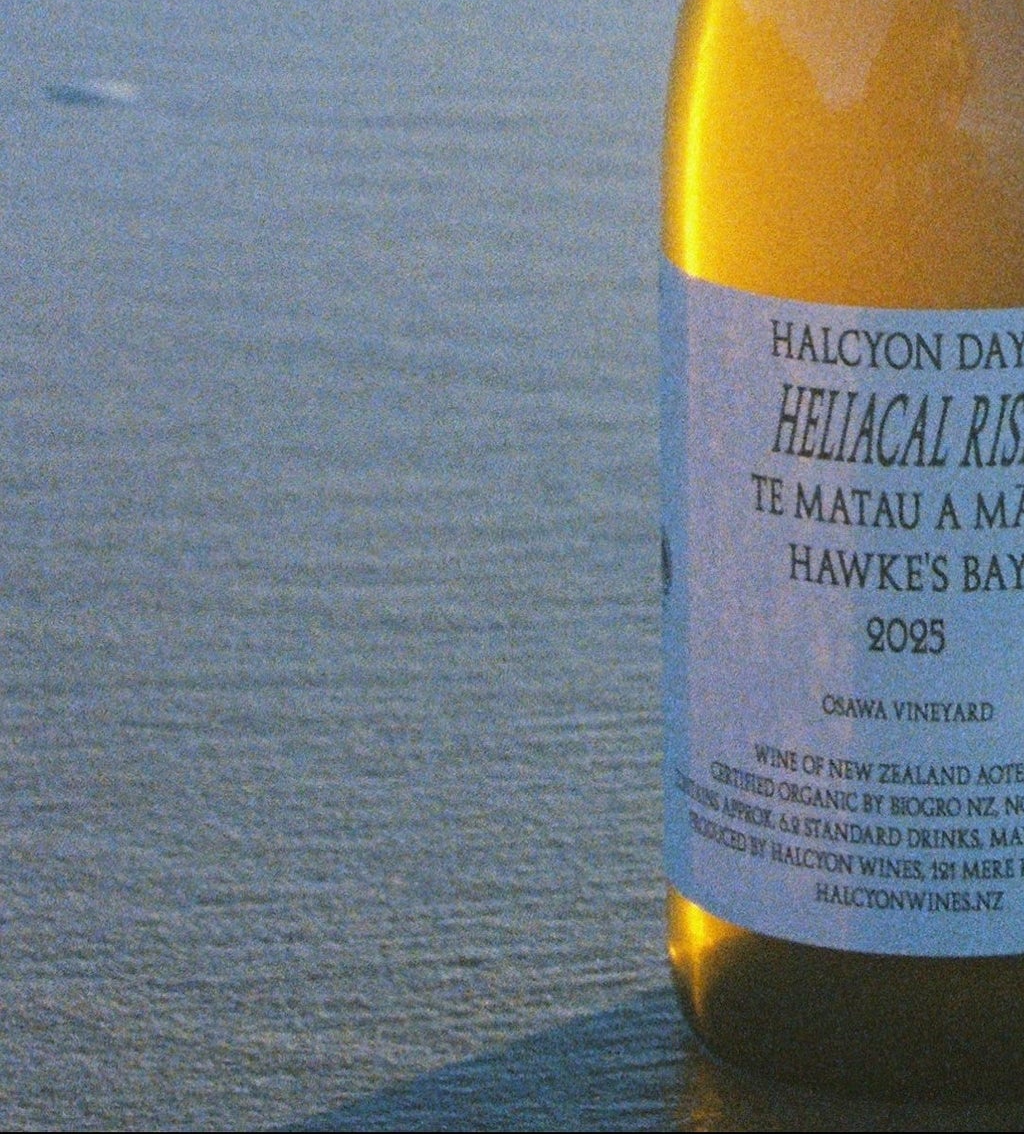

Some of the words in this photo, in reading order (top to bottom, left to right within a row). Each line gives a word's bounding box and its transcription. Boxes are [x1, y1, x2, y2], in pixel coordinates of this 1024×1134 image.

[771, 319, 941, 368] HALCYON
[771, 383, 950, 466] HELIACAL
[751, 473, 784, 515] TE
[793, 483, 921, 530] MATAU
[935, 492, 961, 530] A
[787, 544, 950, 592] HAWKE'S
[866, 617, 946, 654] 2025
[821, 695, 888, 720] OSAWA
[893, 700, 994, 723] VINEYARD
[754, 743, 798, 771] WINE
[802, 755, 824, 775] OF
[828, 759, 871, 781] NEW
[878, 763, 971, 785] ZEALAND
[778, 781, 859, 812] ORGANIC
[862, 793, 884, 814] BY
[890, 796, 962, 817] BIOGRO
[804, 817, 901, 846] STANDARD
[770, 841, 852, 874] HALCYON
[962, 859, 1015, 879] MERE
[816, 883, 1004, 912] HALCYONWINES.NZ
